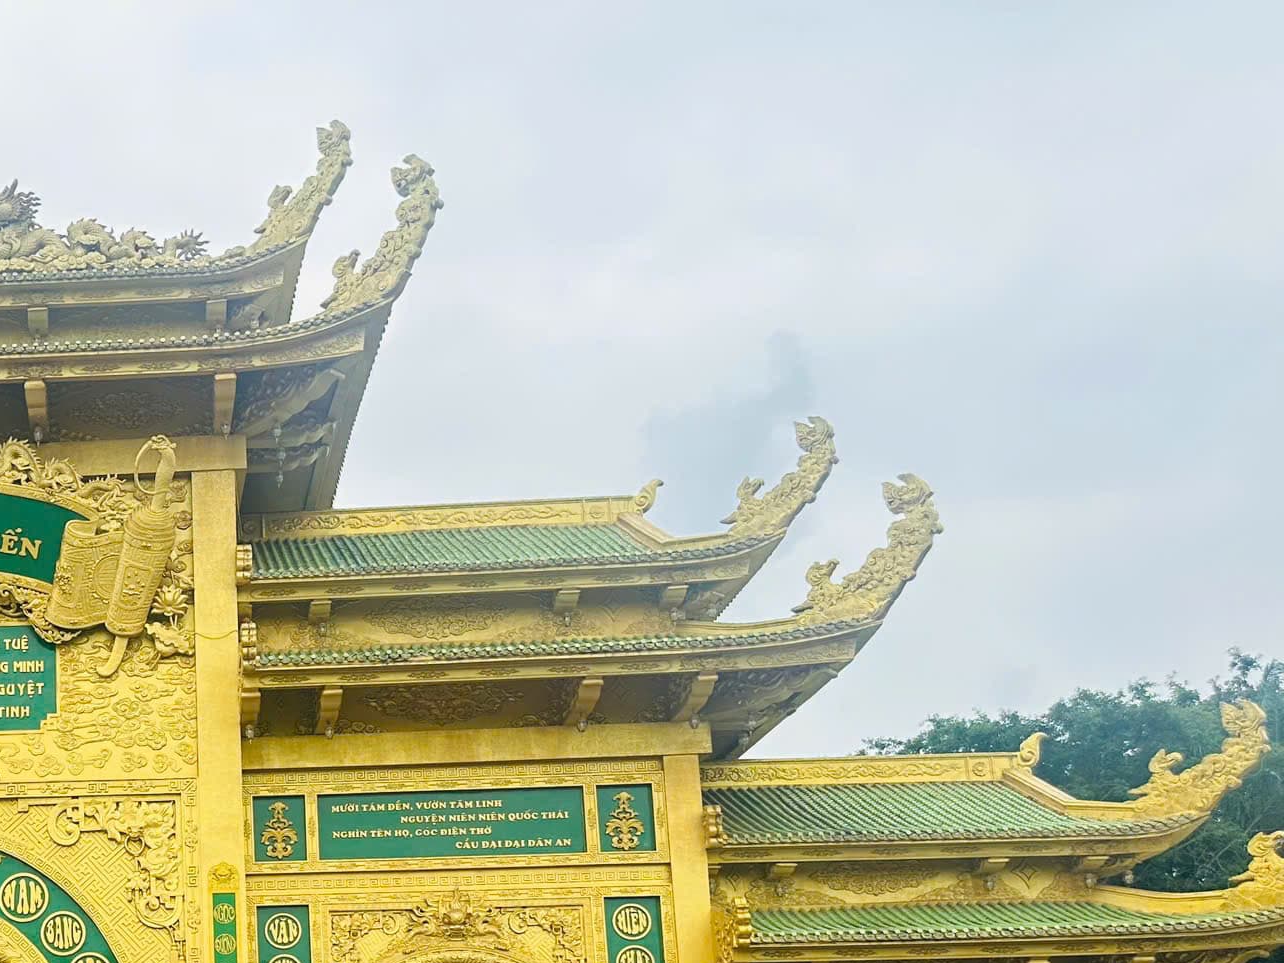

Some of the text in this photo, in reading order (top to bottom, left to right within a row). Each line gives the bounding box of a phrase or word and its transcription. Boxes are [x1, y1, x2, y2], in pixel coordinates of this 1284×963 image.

[4, 635, 28, 652] TUỆ
[14, 661, 44, 672] MINH
[3, 878, 43, 916] NAM
[45, 915, 80, 950] BANG
